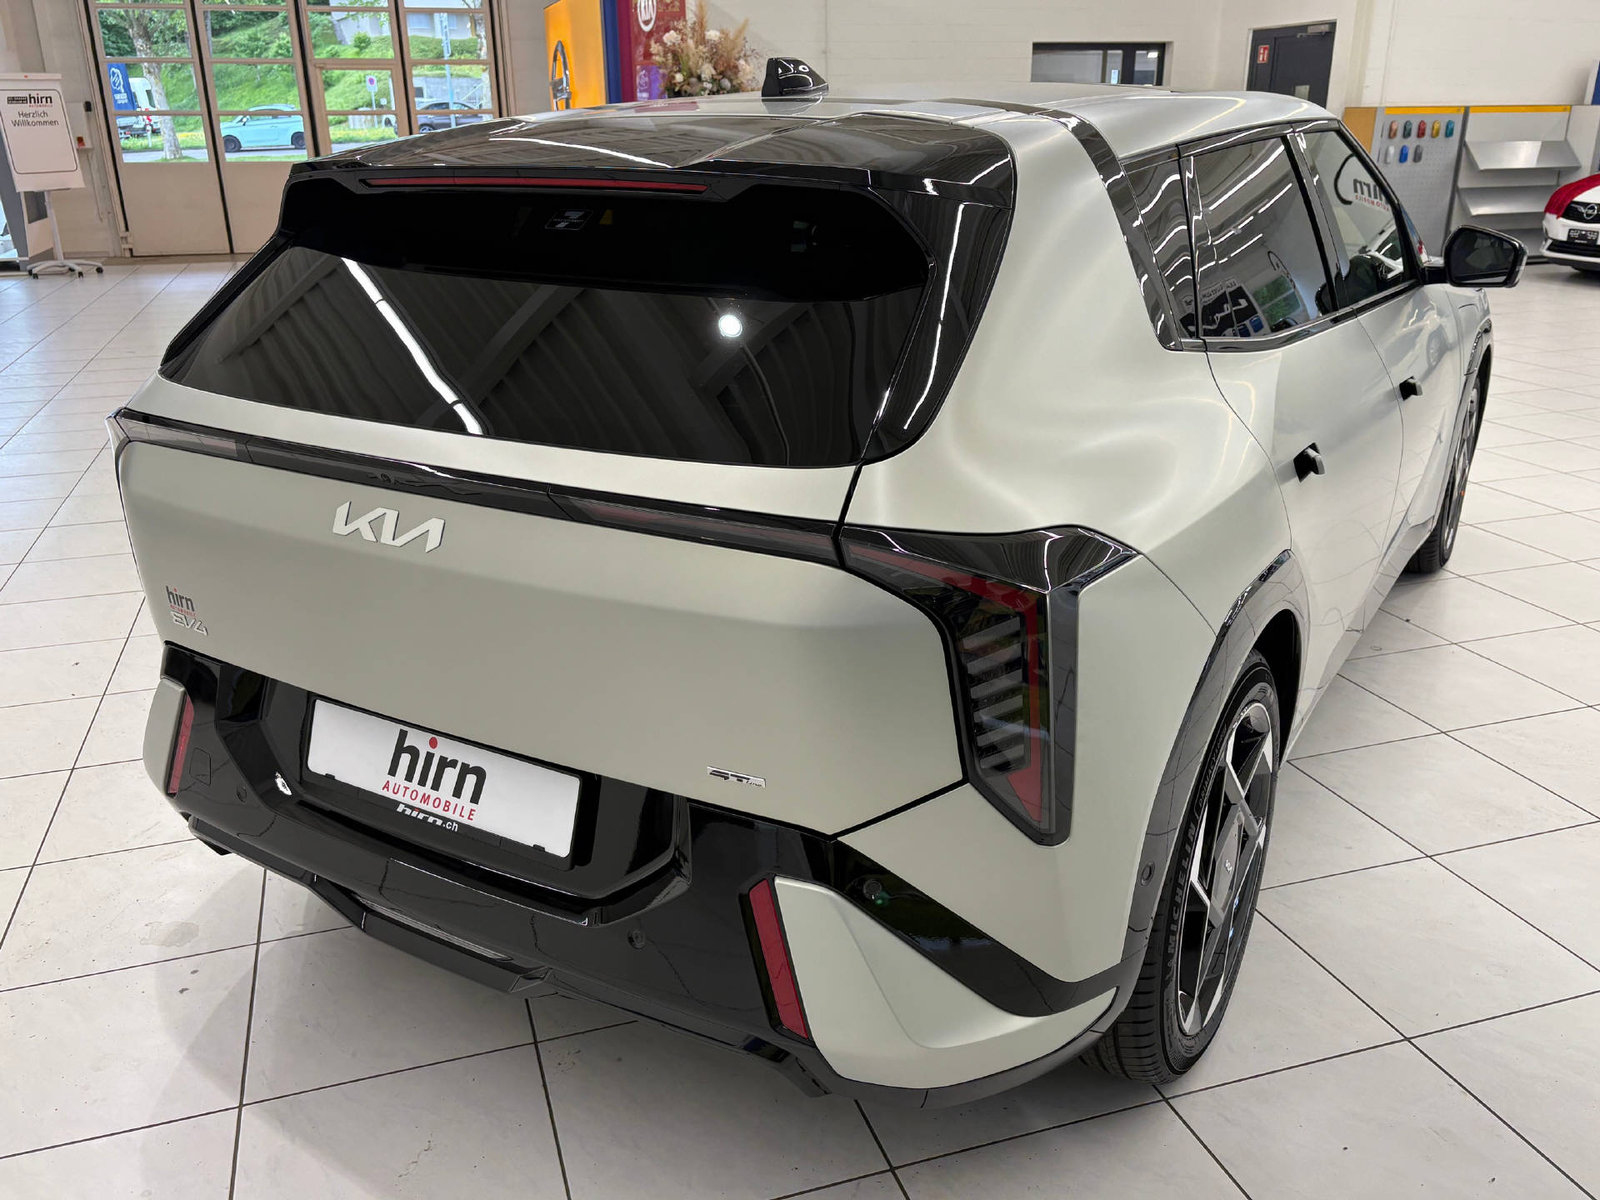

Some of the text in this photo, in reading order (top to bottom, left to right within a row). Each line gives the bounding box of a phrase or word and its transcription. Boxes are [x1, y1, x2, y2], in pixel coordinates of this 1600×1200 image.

[28, 93, 53, 104] hirn
[11, 119, 60, 127] Willkommen
[18, 110, 49, 119] Herzlich
[332, 500, 446, 553] KIA
[166, 585, 195, 612] hirn
[170, 610, 208, 636] EV4
[388, 728, 487, 805] hirn
[382, 780, 477, 821] AUTOMOBILE
[1167, 823, 1198, 954] MICHELIN
